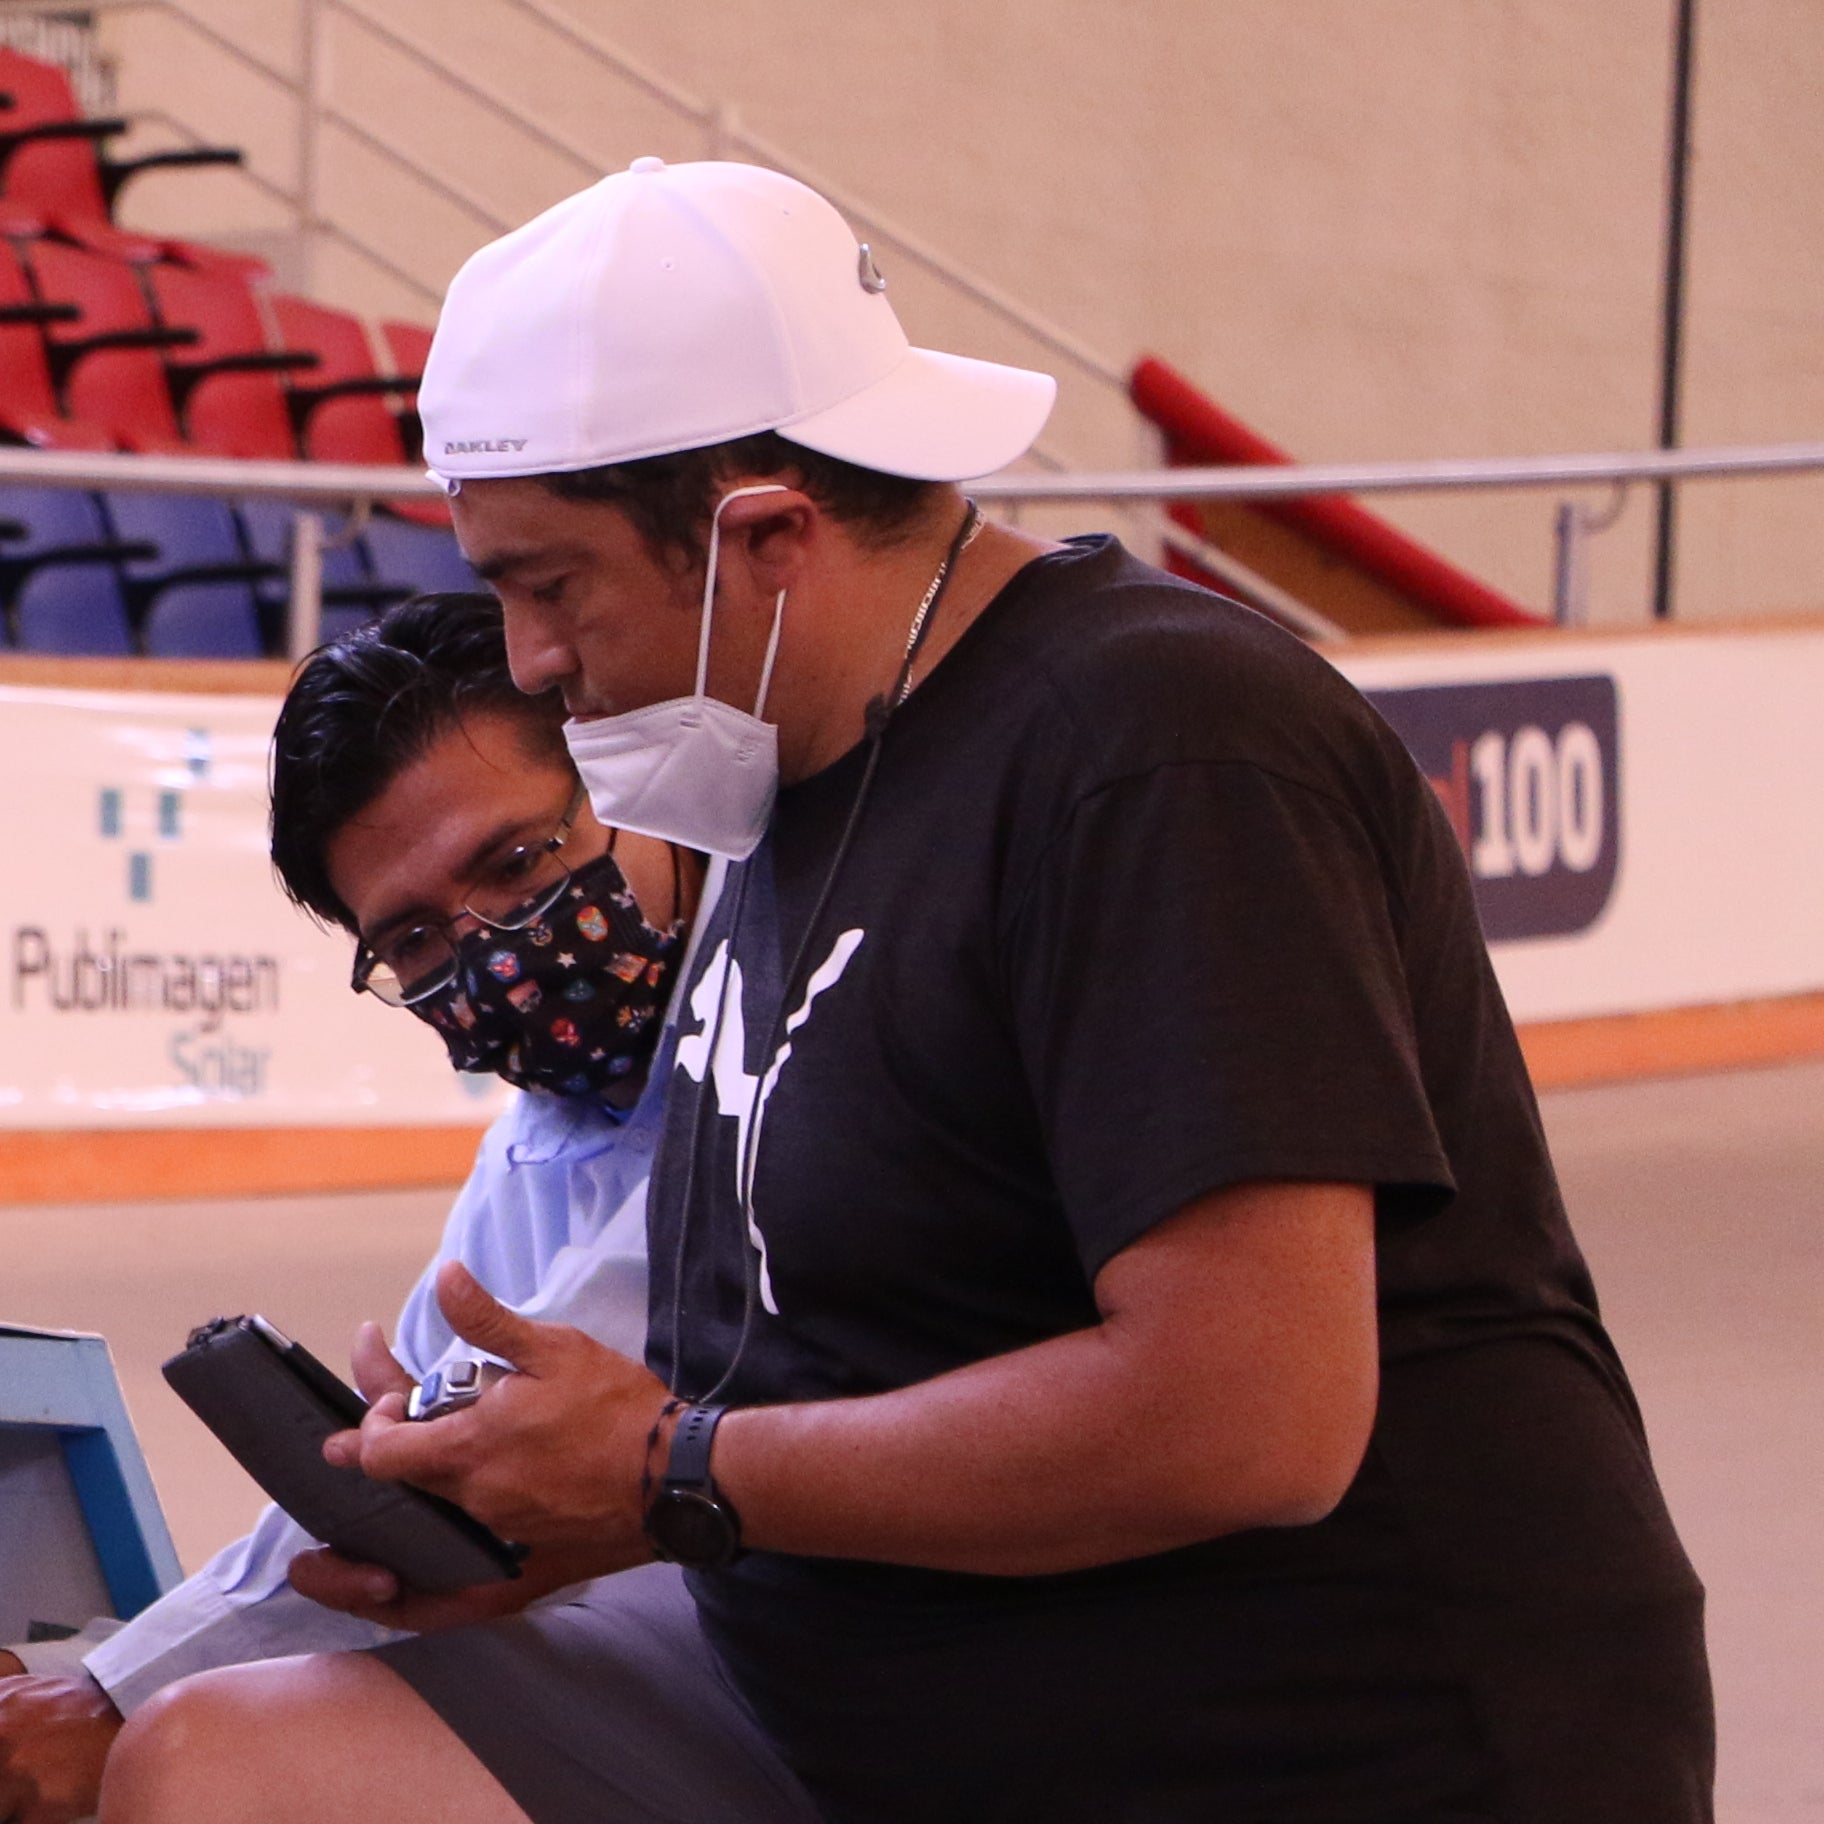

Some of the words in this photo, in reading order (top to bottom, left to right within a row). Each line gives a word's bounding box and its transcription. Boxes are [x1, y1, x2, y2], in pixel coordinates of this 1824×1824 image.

[444, 438, 528, 456] OAKLEY
[10, 924, 282, 1034] Publimagen
[168, 1026, 273, 1096] Solar
